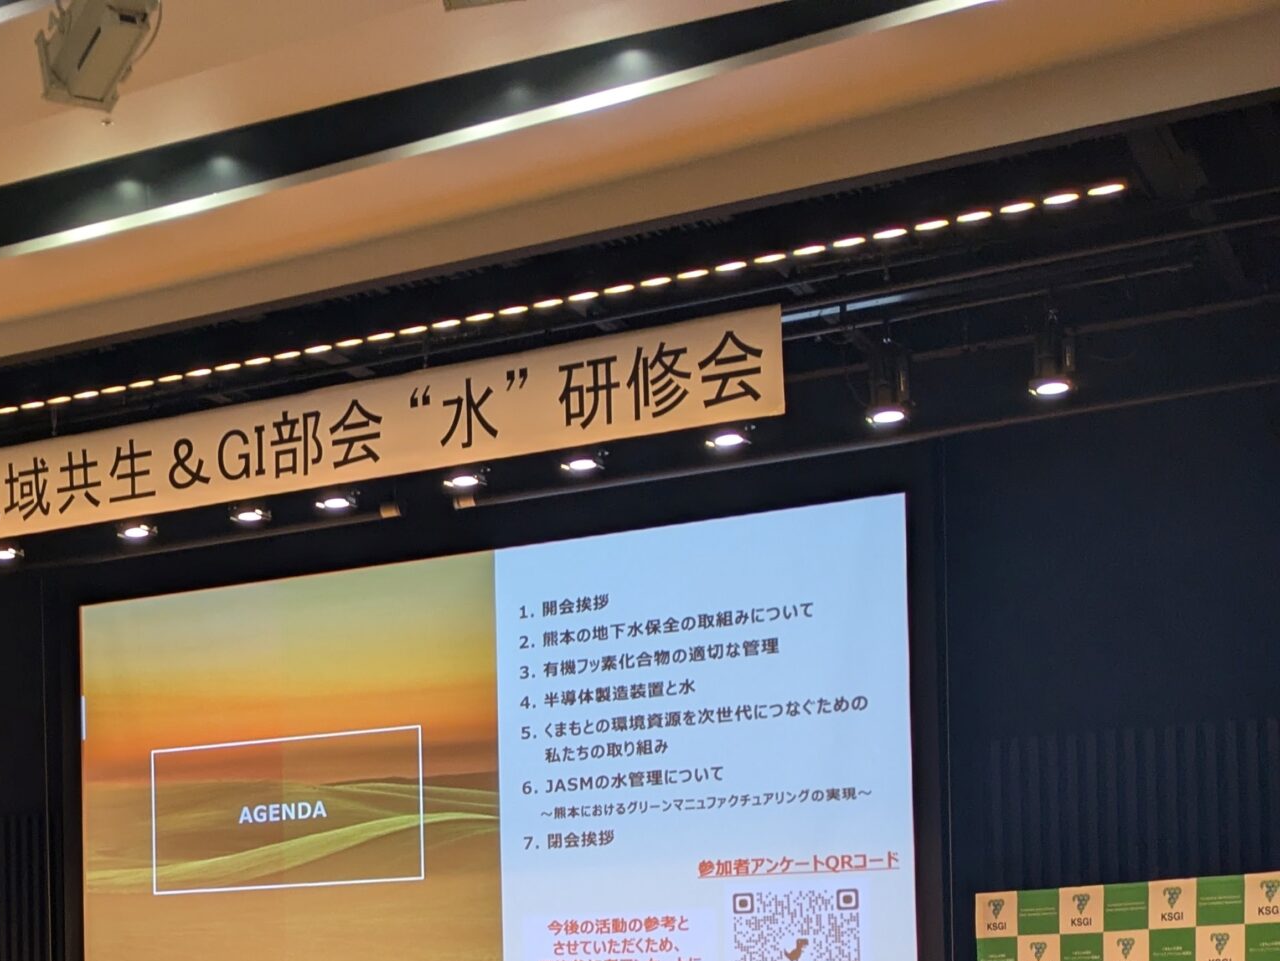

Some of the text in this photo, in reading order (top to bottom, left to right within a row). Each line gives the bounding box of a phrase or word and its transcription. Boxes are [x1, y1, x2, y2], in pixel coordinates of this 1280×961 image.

[557, 331, 764, 429] 研修会
[519, 593, 609, 619] 1. 開会挨拶
[519, 602, 814, 650] 2. 熊本の地下水保全の取組みについて
[519, 637, 779, 680] 3. 有機フッ素化合物の適切な管理
[520, 679, 696, 709] 4. 半導体製造装置と水
[521, 695, 868, 740] 5. くまもとの環境資源を次世代につなぐための
[545, 739, 668, 764] 私たちの取り組み
[522, 767, 724, 795] 6. JASMの水管理について
[239, 801, 327, 824] AGENDA
[524, 829, 614, 850] 7. 閉会挨拶
[699, 850, 899, 877] 参加者アンケートQRコード
[1257, 905, 1280, 917] KSG
[548, 916, 690, 935] 今後の活動の参考と
[553, 937, 680, 955] させていただくため、
